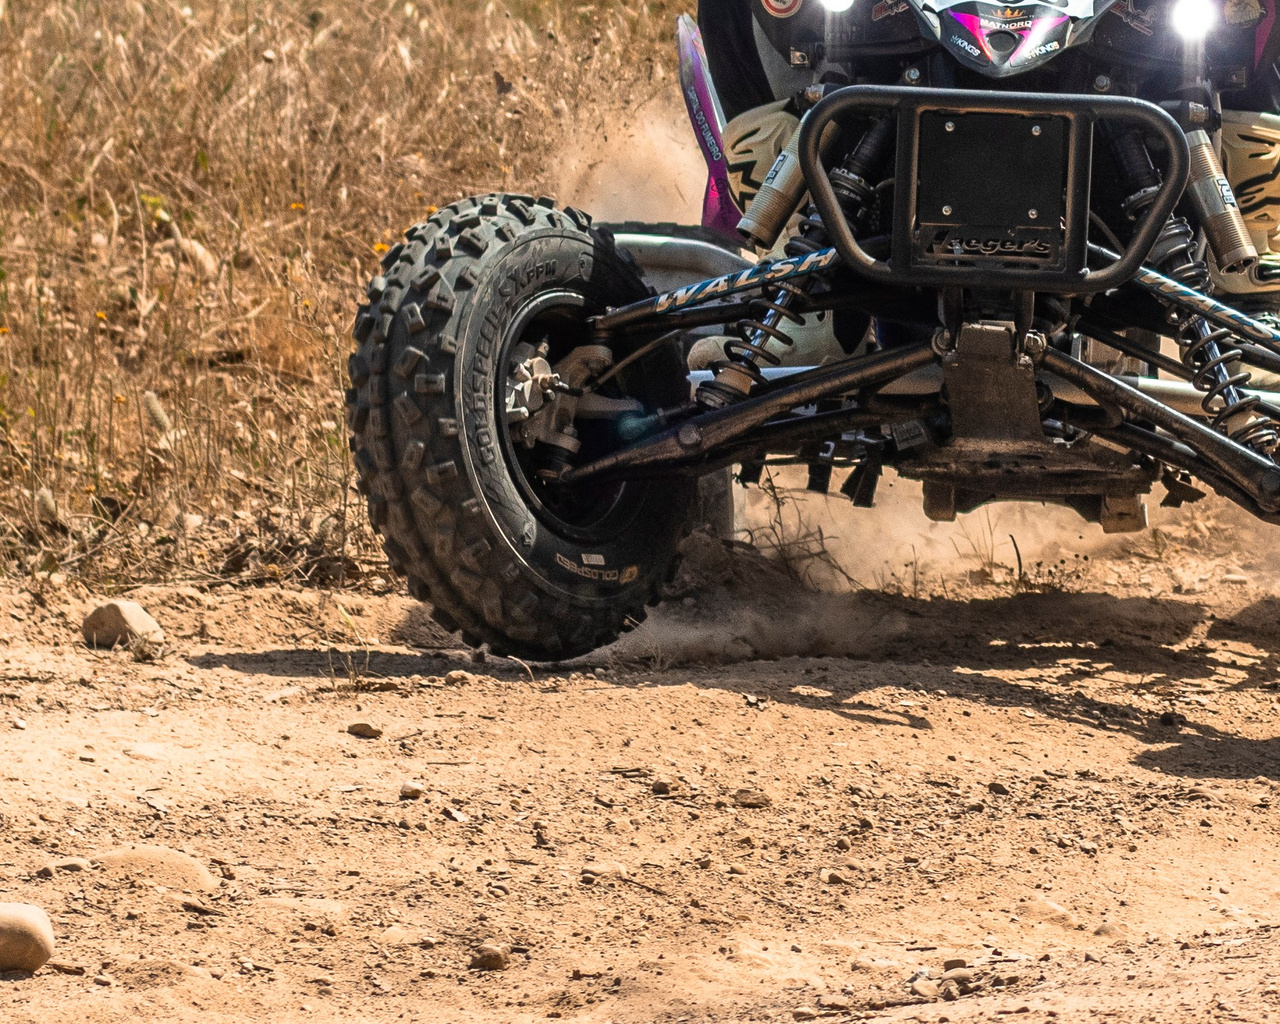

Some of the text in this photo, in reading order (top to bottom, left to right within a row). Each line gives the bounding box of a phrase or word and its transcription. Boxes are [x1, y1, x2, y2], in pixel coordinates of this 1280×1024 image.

[700, 122, 722, 162] FUMEIRO
[655, 247, 837, 313] WALSH
[556, 553, 619, 581] GOLDSPEED
